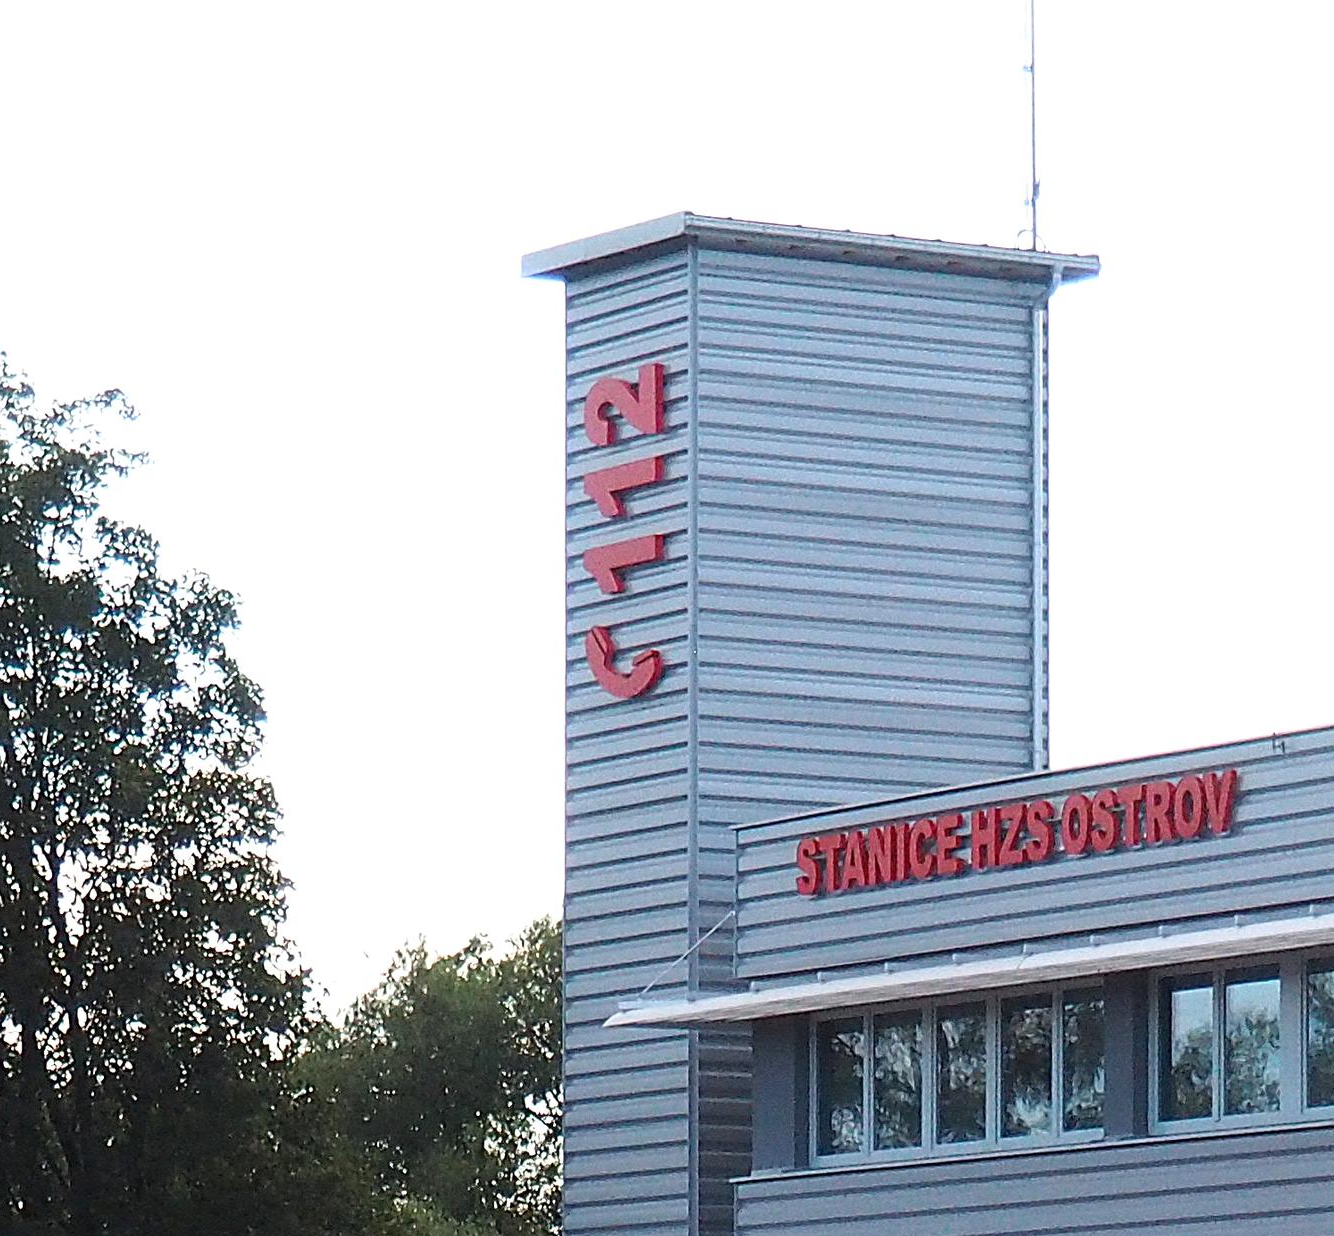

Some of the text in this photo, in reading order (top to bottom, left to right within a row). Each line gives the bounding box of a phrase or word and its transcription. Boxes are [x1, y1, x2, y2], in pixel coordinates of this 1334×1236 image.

[583, 362, 665, 594] 112
[795, 769, 1239, 896] STANICE HZS OSTROV
